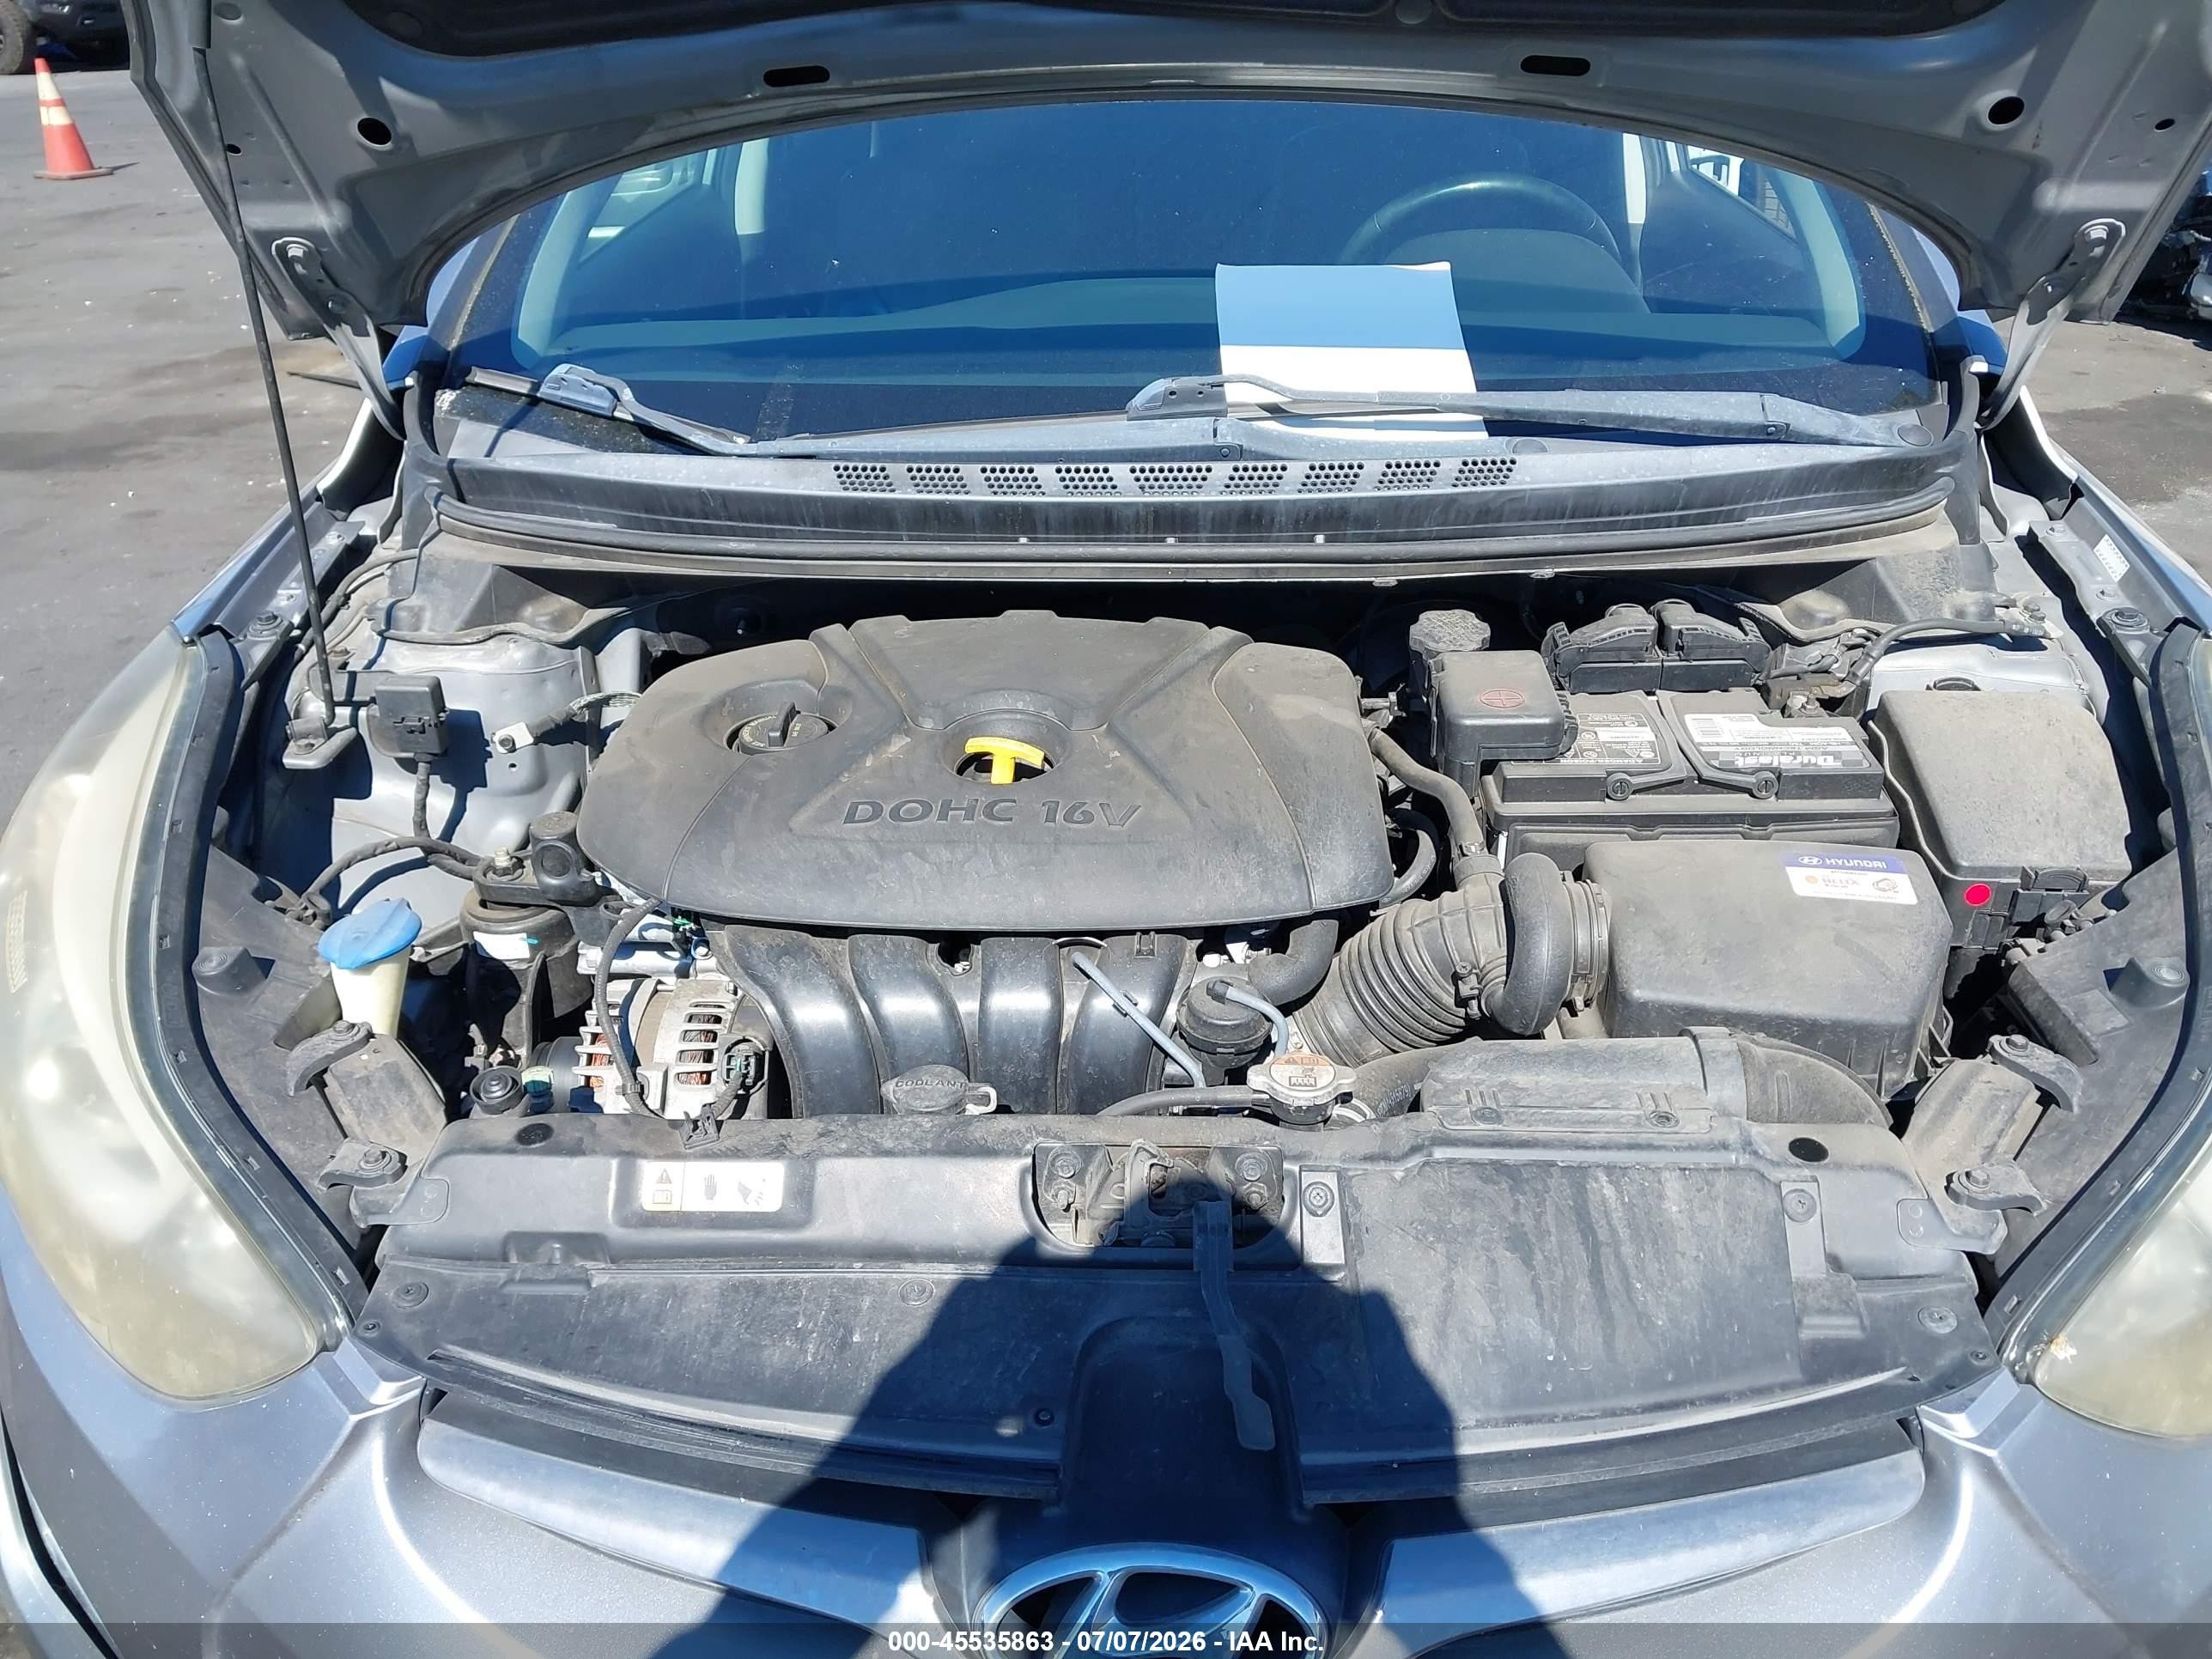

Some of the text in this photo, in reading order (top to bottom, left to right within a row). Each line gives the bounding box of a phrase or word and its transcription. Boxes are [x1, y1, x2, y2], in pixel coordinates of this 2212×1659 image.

[1735, 755, 1842, 768] Duralast
[842, 797, 1142, 830] DOHC 16V
[1825, 857, 1887, 869] HYUNDAI
[894, 1079, 967, 1090] COOLANT
